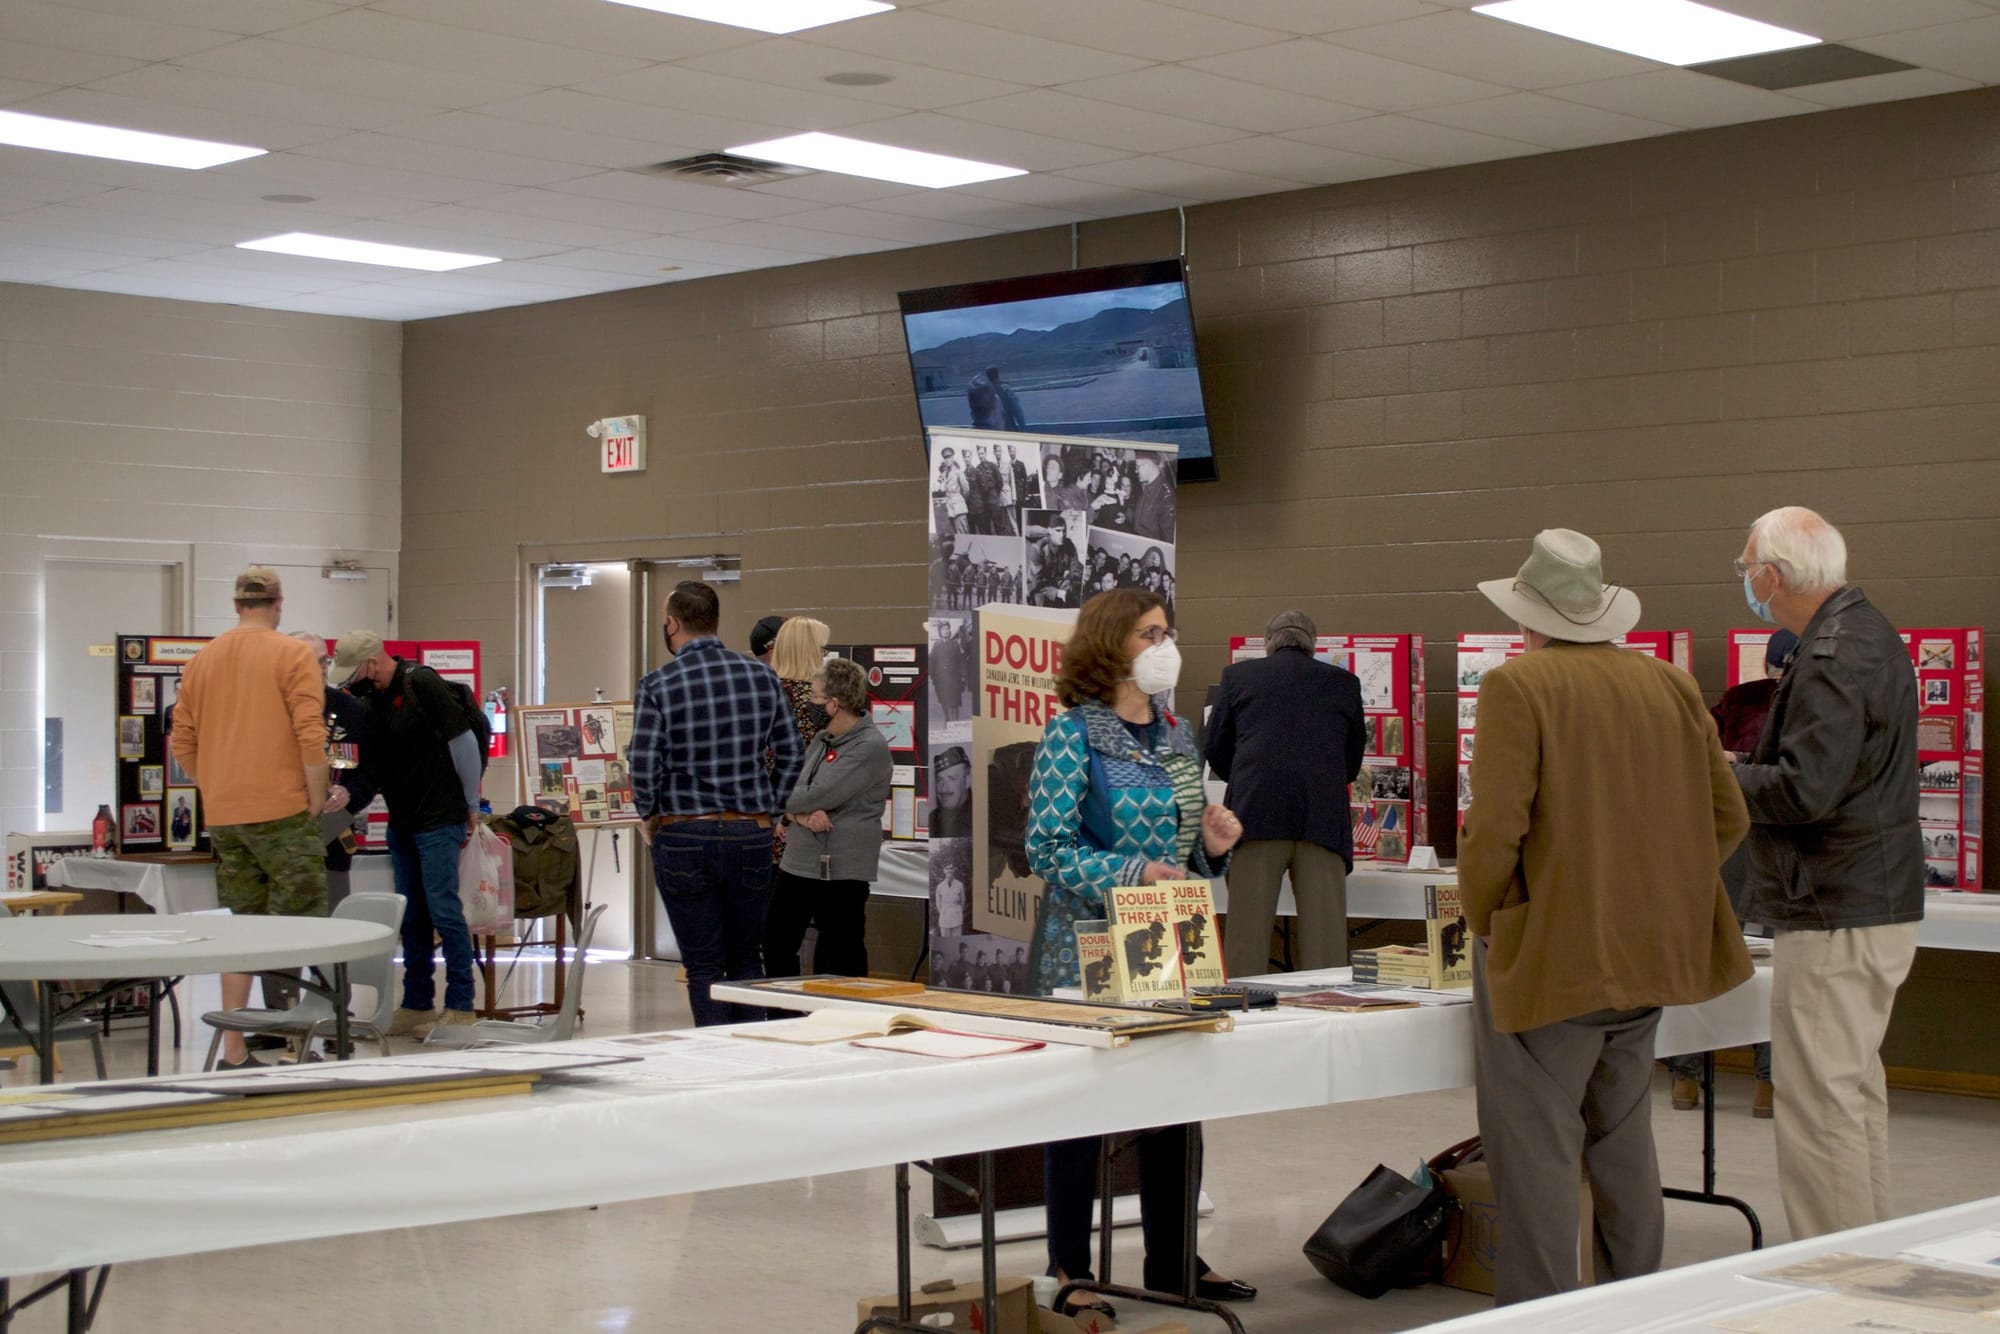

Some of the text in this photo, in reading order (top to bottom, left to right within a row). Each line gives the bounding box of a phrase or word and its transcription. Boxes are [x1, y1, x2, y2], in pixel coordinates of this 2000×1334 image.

[608, 437, 634, 468] EXIT
[985, 630, 1065, 675] DOUB
[986, 669, 1007, 683] CANADIAN
[1022, 675, 1030, 688] THE
[985, 684, 1059, 729] THRE
[988, 885, 1026, 921] ELLIN
[1116, 892, 1167, 906] DOUBLE
[1118, 911, 1169, 925] THREAT
[1079, 935, 1111, 945] DOUBL
[1081, 948, 1112, 959] THREA
[1196, 968, 1221, 979] BESSNER
[1130, 982, 1150, 993] ELLIN
